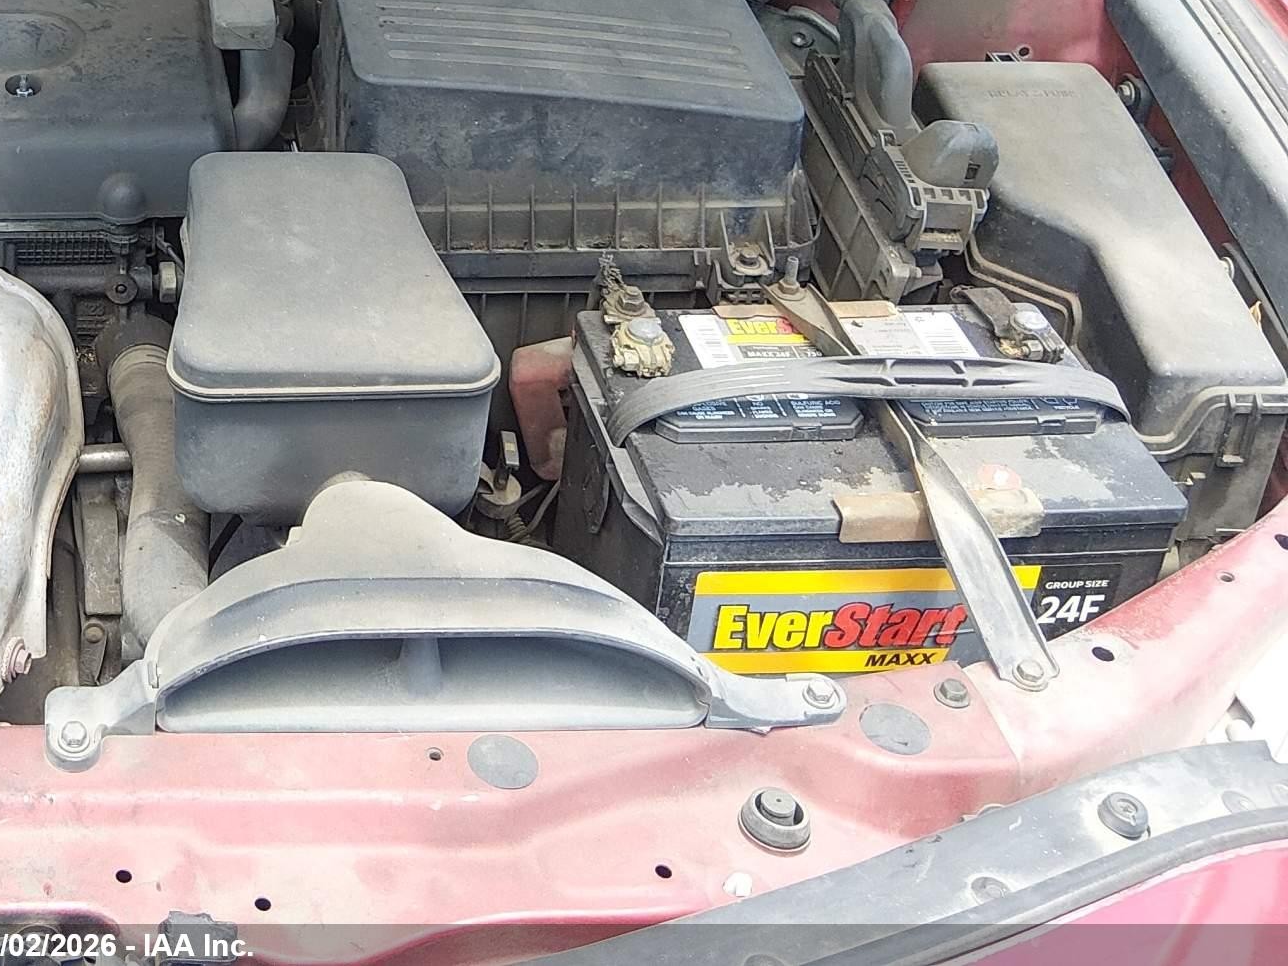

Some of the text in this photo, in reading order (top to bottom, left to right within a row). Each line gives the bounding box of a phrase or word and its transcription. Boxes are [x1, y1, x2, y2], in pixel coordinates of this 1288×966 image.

[1045, 579, 1111, 590] GROUP SIZE
[1036, 594, 1106, 624] 24F
[712, 601, 968, 651] EverStart
[864, 652, 938, 668] MAXX
